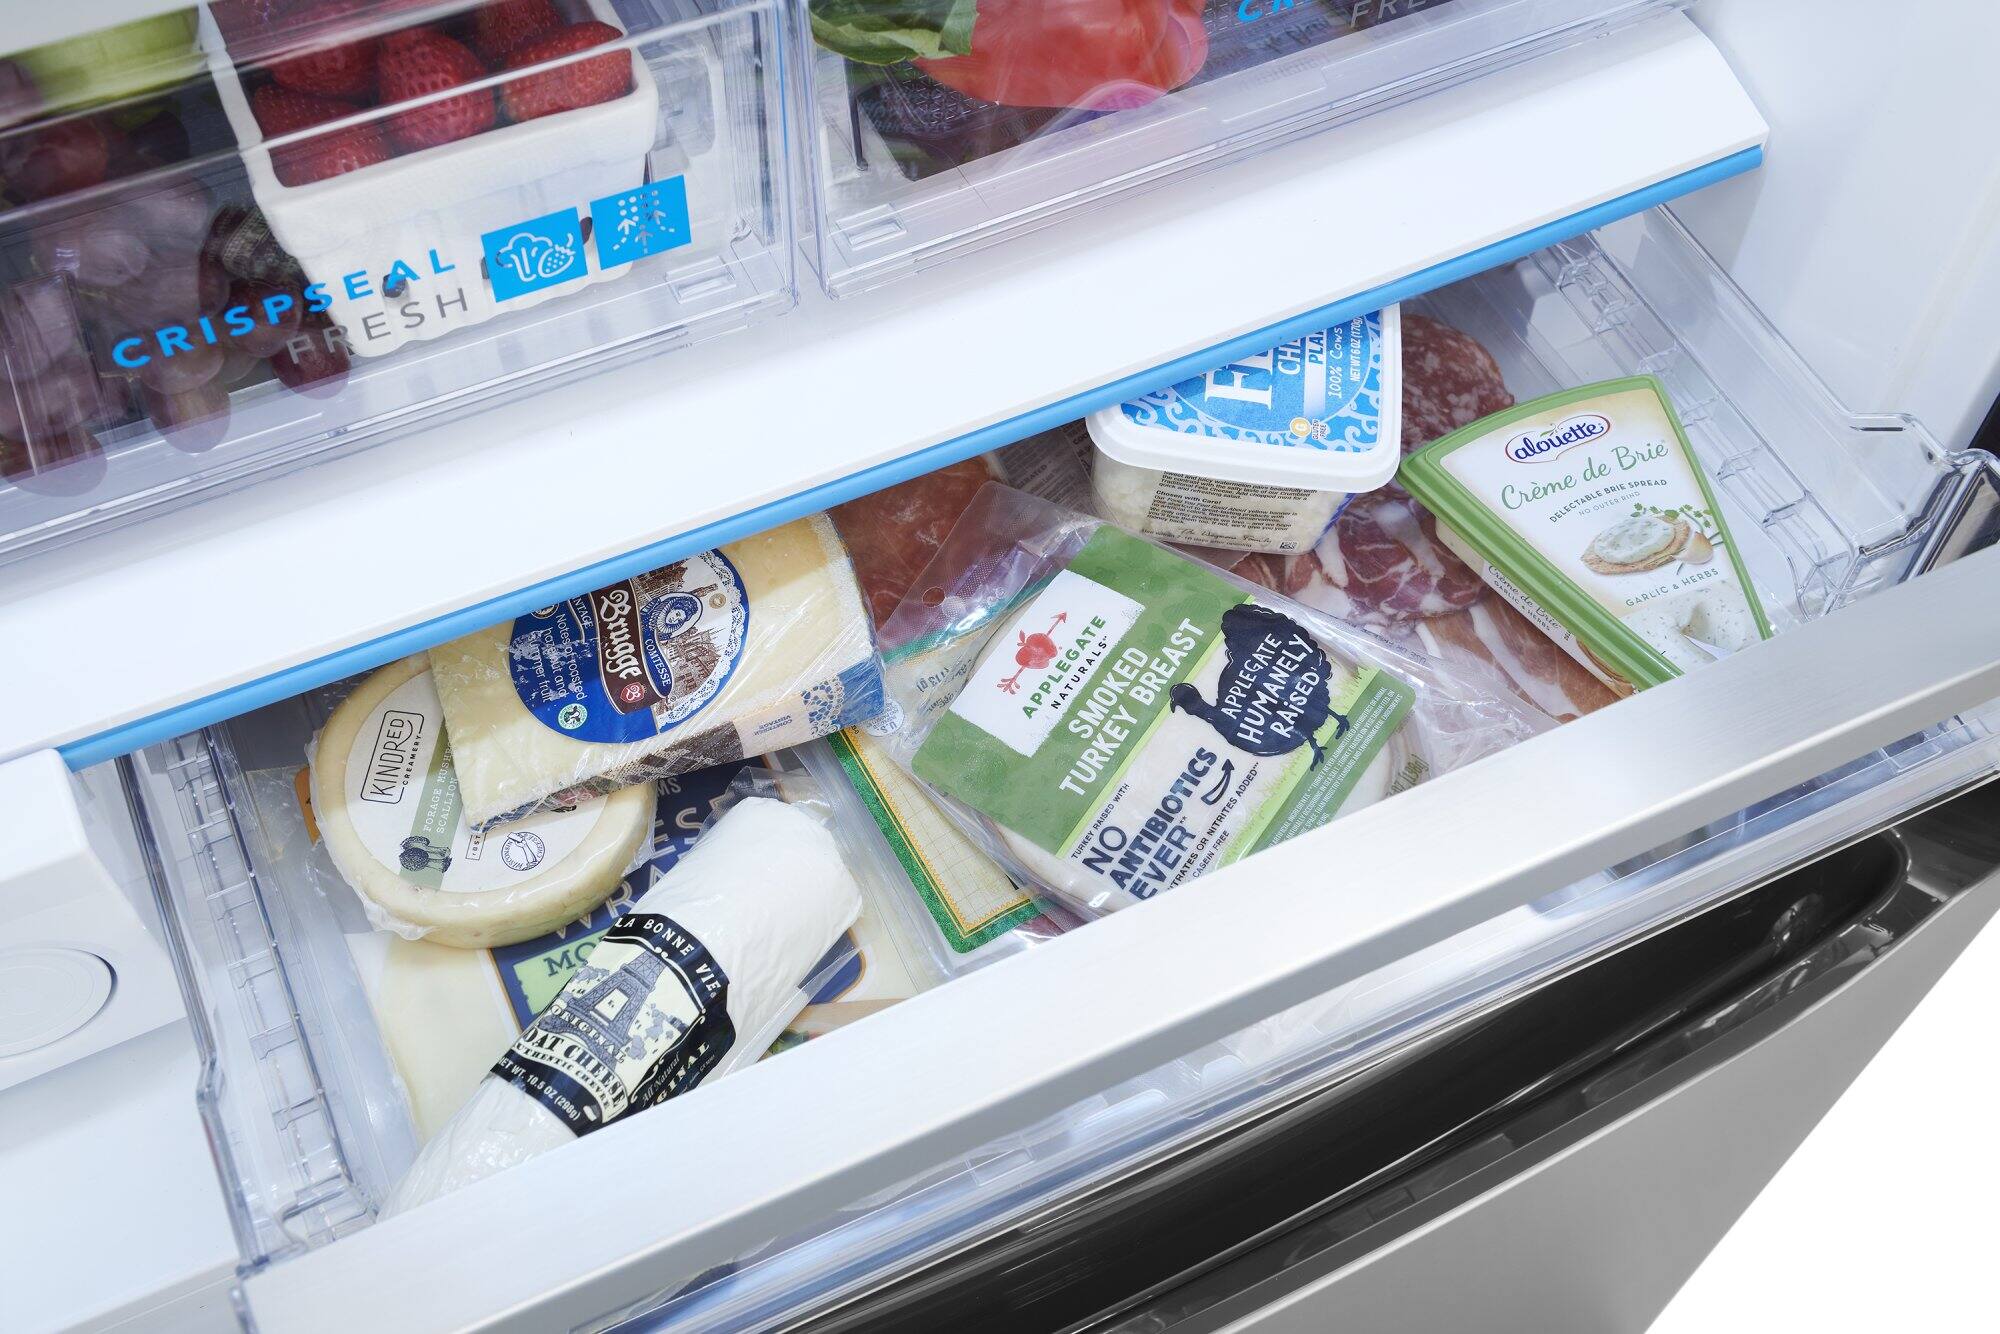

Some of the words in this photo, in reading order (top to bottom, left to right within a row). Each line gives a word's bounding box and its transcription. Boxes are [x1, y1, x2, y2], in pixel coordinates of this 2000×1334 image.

[111, 248, 456, 369] CRISPSEAL
[285, 287, 468, 365] FRESH
[1350, 338, 1359, 348] OZ
[1327, 366, 1342, 398] 100%
[1350, 366, 1360, 380] NET
[1514, 422, 1605, 460] alouette
[1501, 474, 1578, 510] Crème
[1583, 457, 1612, 482] de
[1610, 441, 1668, 471] Brie
[1549, 490, 1603, 523] DELECTABLE
[1603, 482, 1627, 495] BRIE
[1627, 478, 1668, 490] SPREAD
[1579, 507, 1591, 516] NO
[1593, 498, 1619, 512] OUTER
[1620, 491, 1641, 502] RIND
[1625, 585, 1670, 608] GARLIC
[1672, 582, 1680, 590] &
[1681, 568, 1719, 587] HERBS
[554, 613, 573, 644] Notes
[563, 645, 576, 657] of
[600, 589, 642, 680] Brugge
[552, 674, 568, 697] and
[564, 659, 587, 700] roasted
[644, 638, 672, 688] COMTESSE
[1022, 615, 1107, 720] APPLEGATE
[1050, 638, 1108, 710] NATURALS
[1220, 632, 1283, 720] APPLEGATE
[1236, 633, 1314, 744] HUMANELY
[1058, 704, 1138, 797] TURKEY
[1128, 617, 1205, 706] BREAST
[1068, 646, 1149, 739] SMOKED
[370, 717, 405, 797] KINDRED
[403, 735, 423, 785] CREAMERY
[423, 788, 442, 833] FORAGE
[436, 778, 459, 834] SCALLION
[1071, 830, 1095, 860] TURKEY
[1093, 804, 1115, 831] RAISED
[1114, 782, 1131, 803] WITH
[1109, 747, 1218, 890] ANTIBIOTICS
[1196, 837, 1209, 852] OR
[1206, 797, 1238, 837] NITRITES
[1081, 826, 1128, 876] NO
[1192, 848, 1215, 878] CASEIN
[1212, 829, 1230, 852] FREE
[614, 917, 634, 929] LA
[645, 918, 695, 957] BONNE
[695, 962, 722, 992] VIE
[550, 1004, 626, 1064] ORIGINAL
[511, 1063, 527, 1080] WT.
[526, 1073, 546, 1091] 10.5
[543, 1084, 558, 1100] OZ
[554, 1094, 582, 1121] (298g)
[563, 1043, 628, 1109] CHEESE
